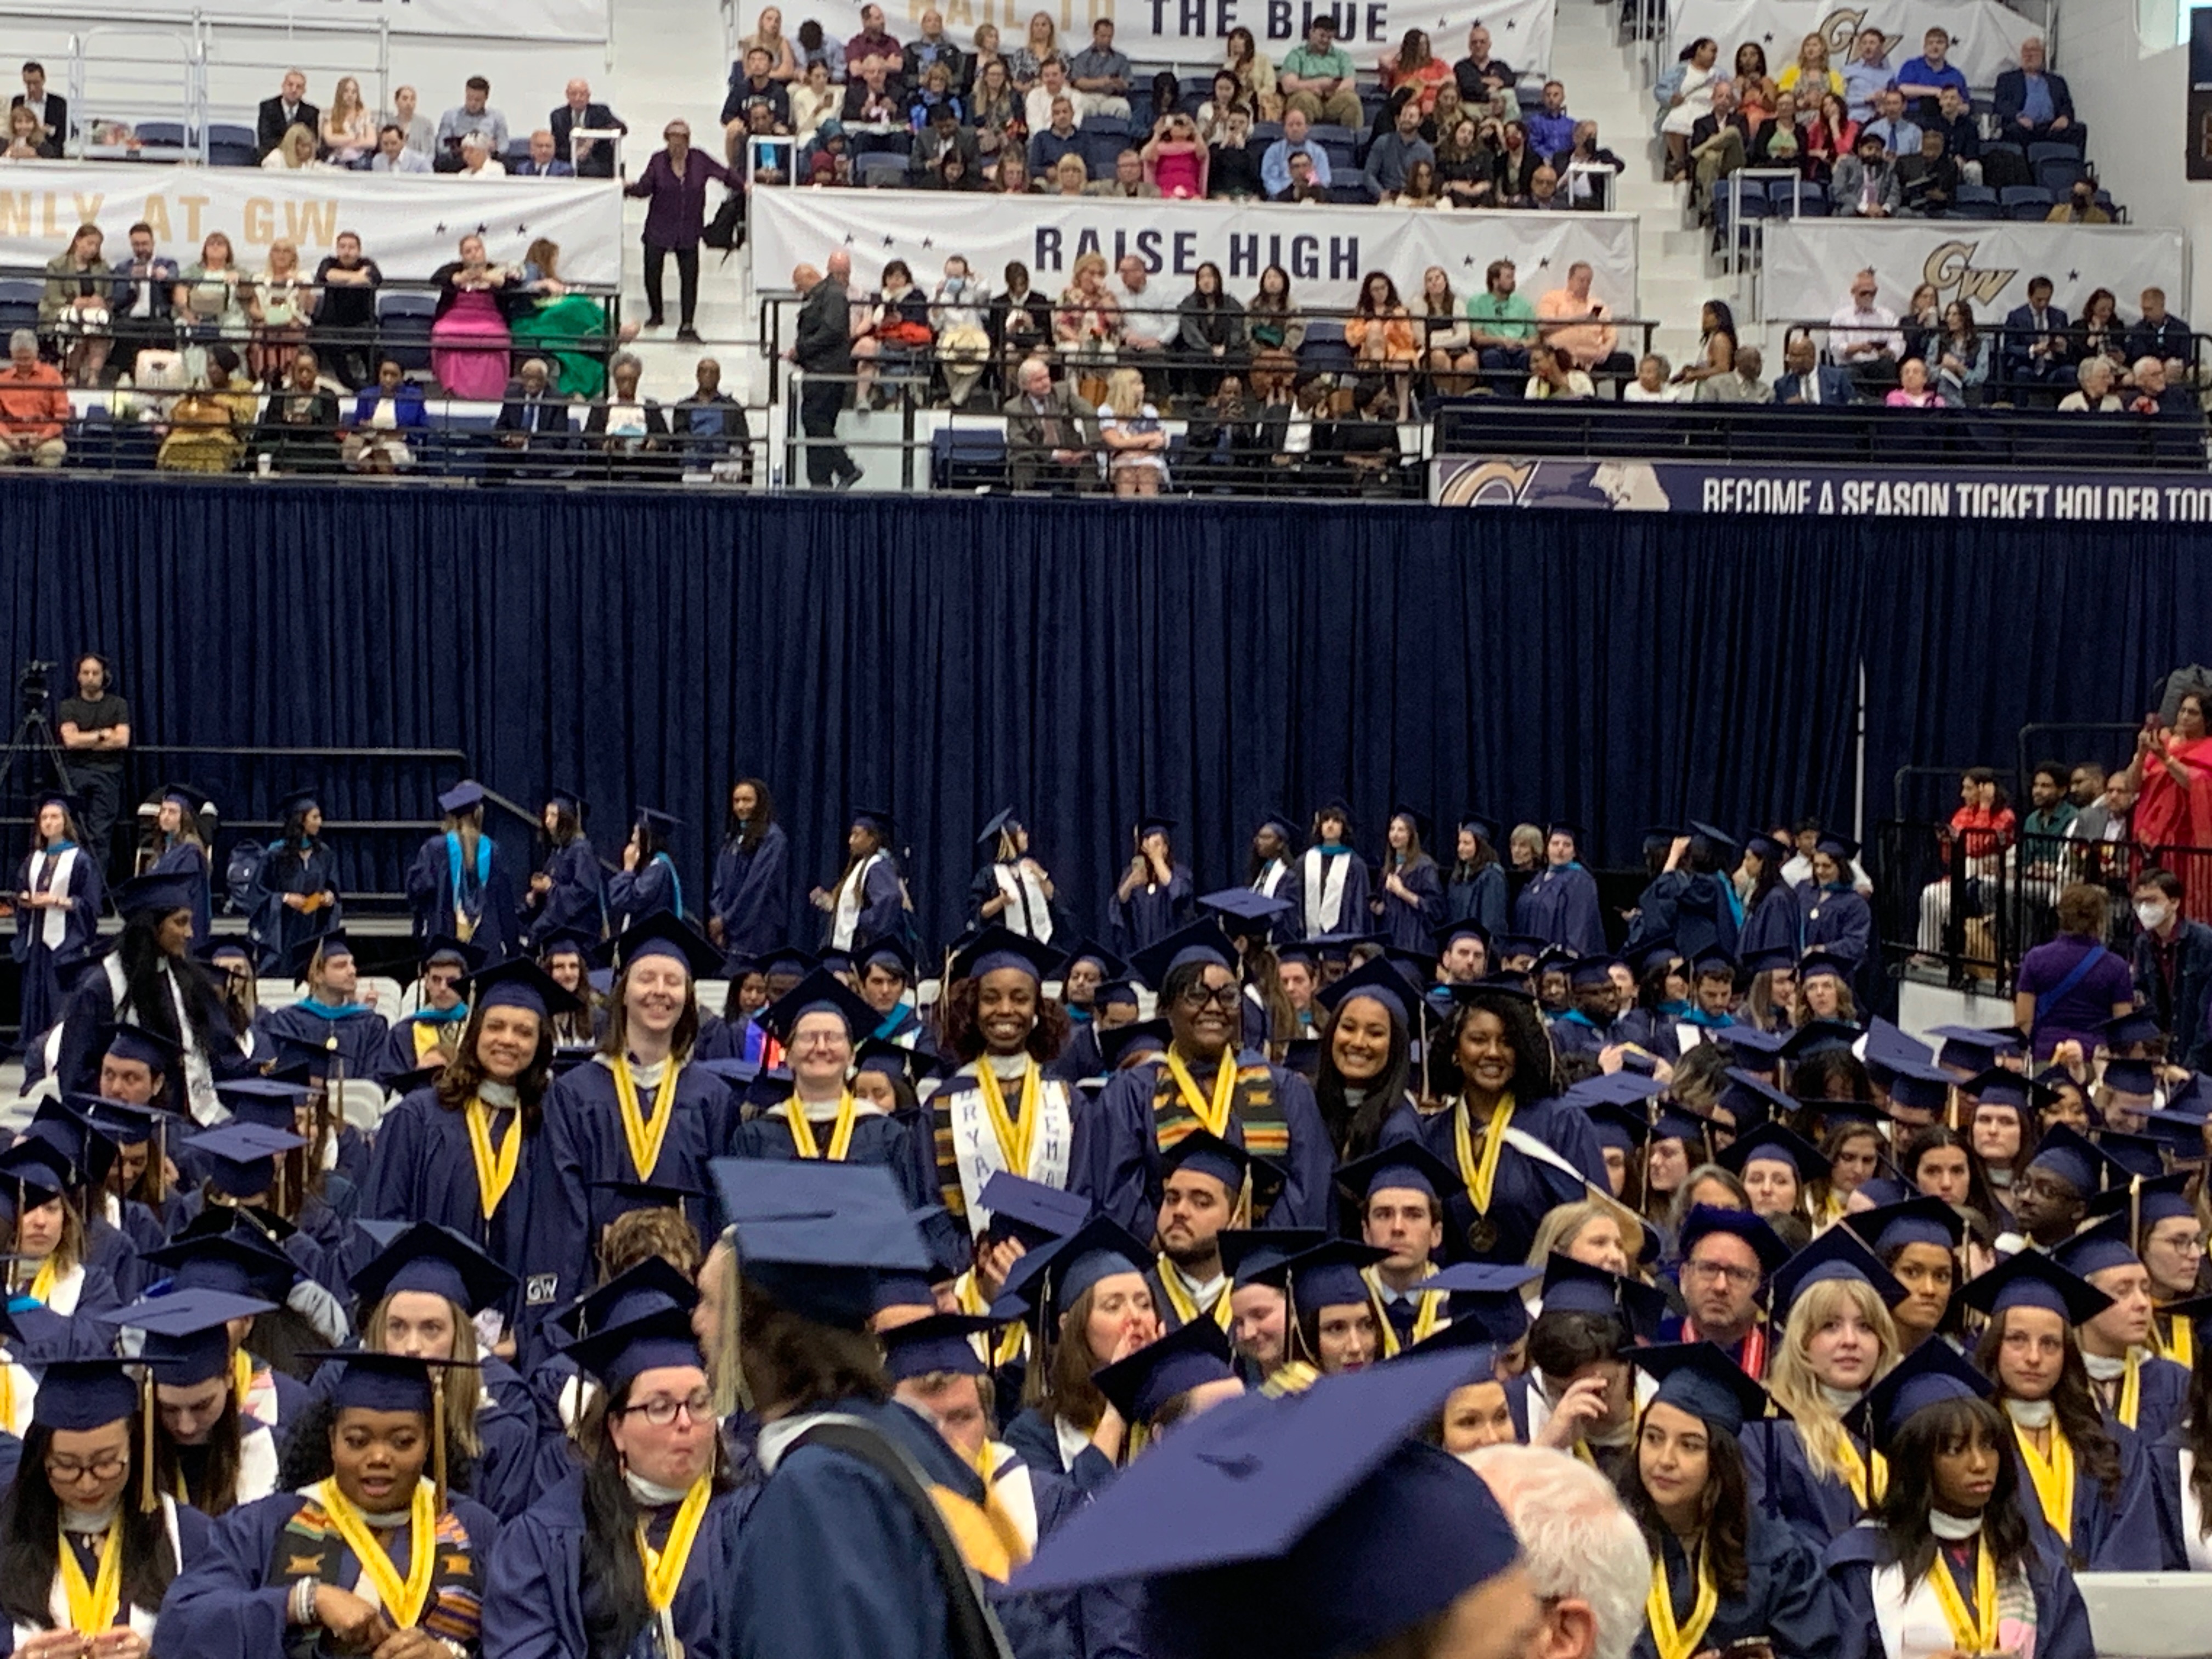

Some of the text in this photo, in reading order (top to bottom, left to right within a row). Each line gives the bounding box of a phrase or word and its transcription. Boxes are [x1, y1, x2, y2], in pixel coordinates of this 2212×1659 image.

[1144, 0, 1238, 38] THE
[1267, 0, 1387, 42] BLUE
[142, 193, 211, 242] AT
[244, 197, 338, 246] GW
[1035, 227, 1358, 281] RAISE HIGH
[1702, 477, 1812, 515] BECOME
[1818, 479, 1835, 516] A
[1841, 480, 1951, 517] SEASON
[1955, 482, 2050, 520] TICKET
[2055, 485, 2160, 522] HOLDER
